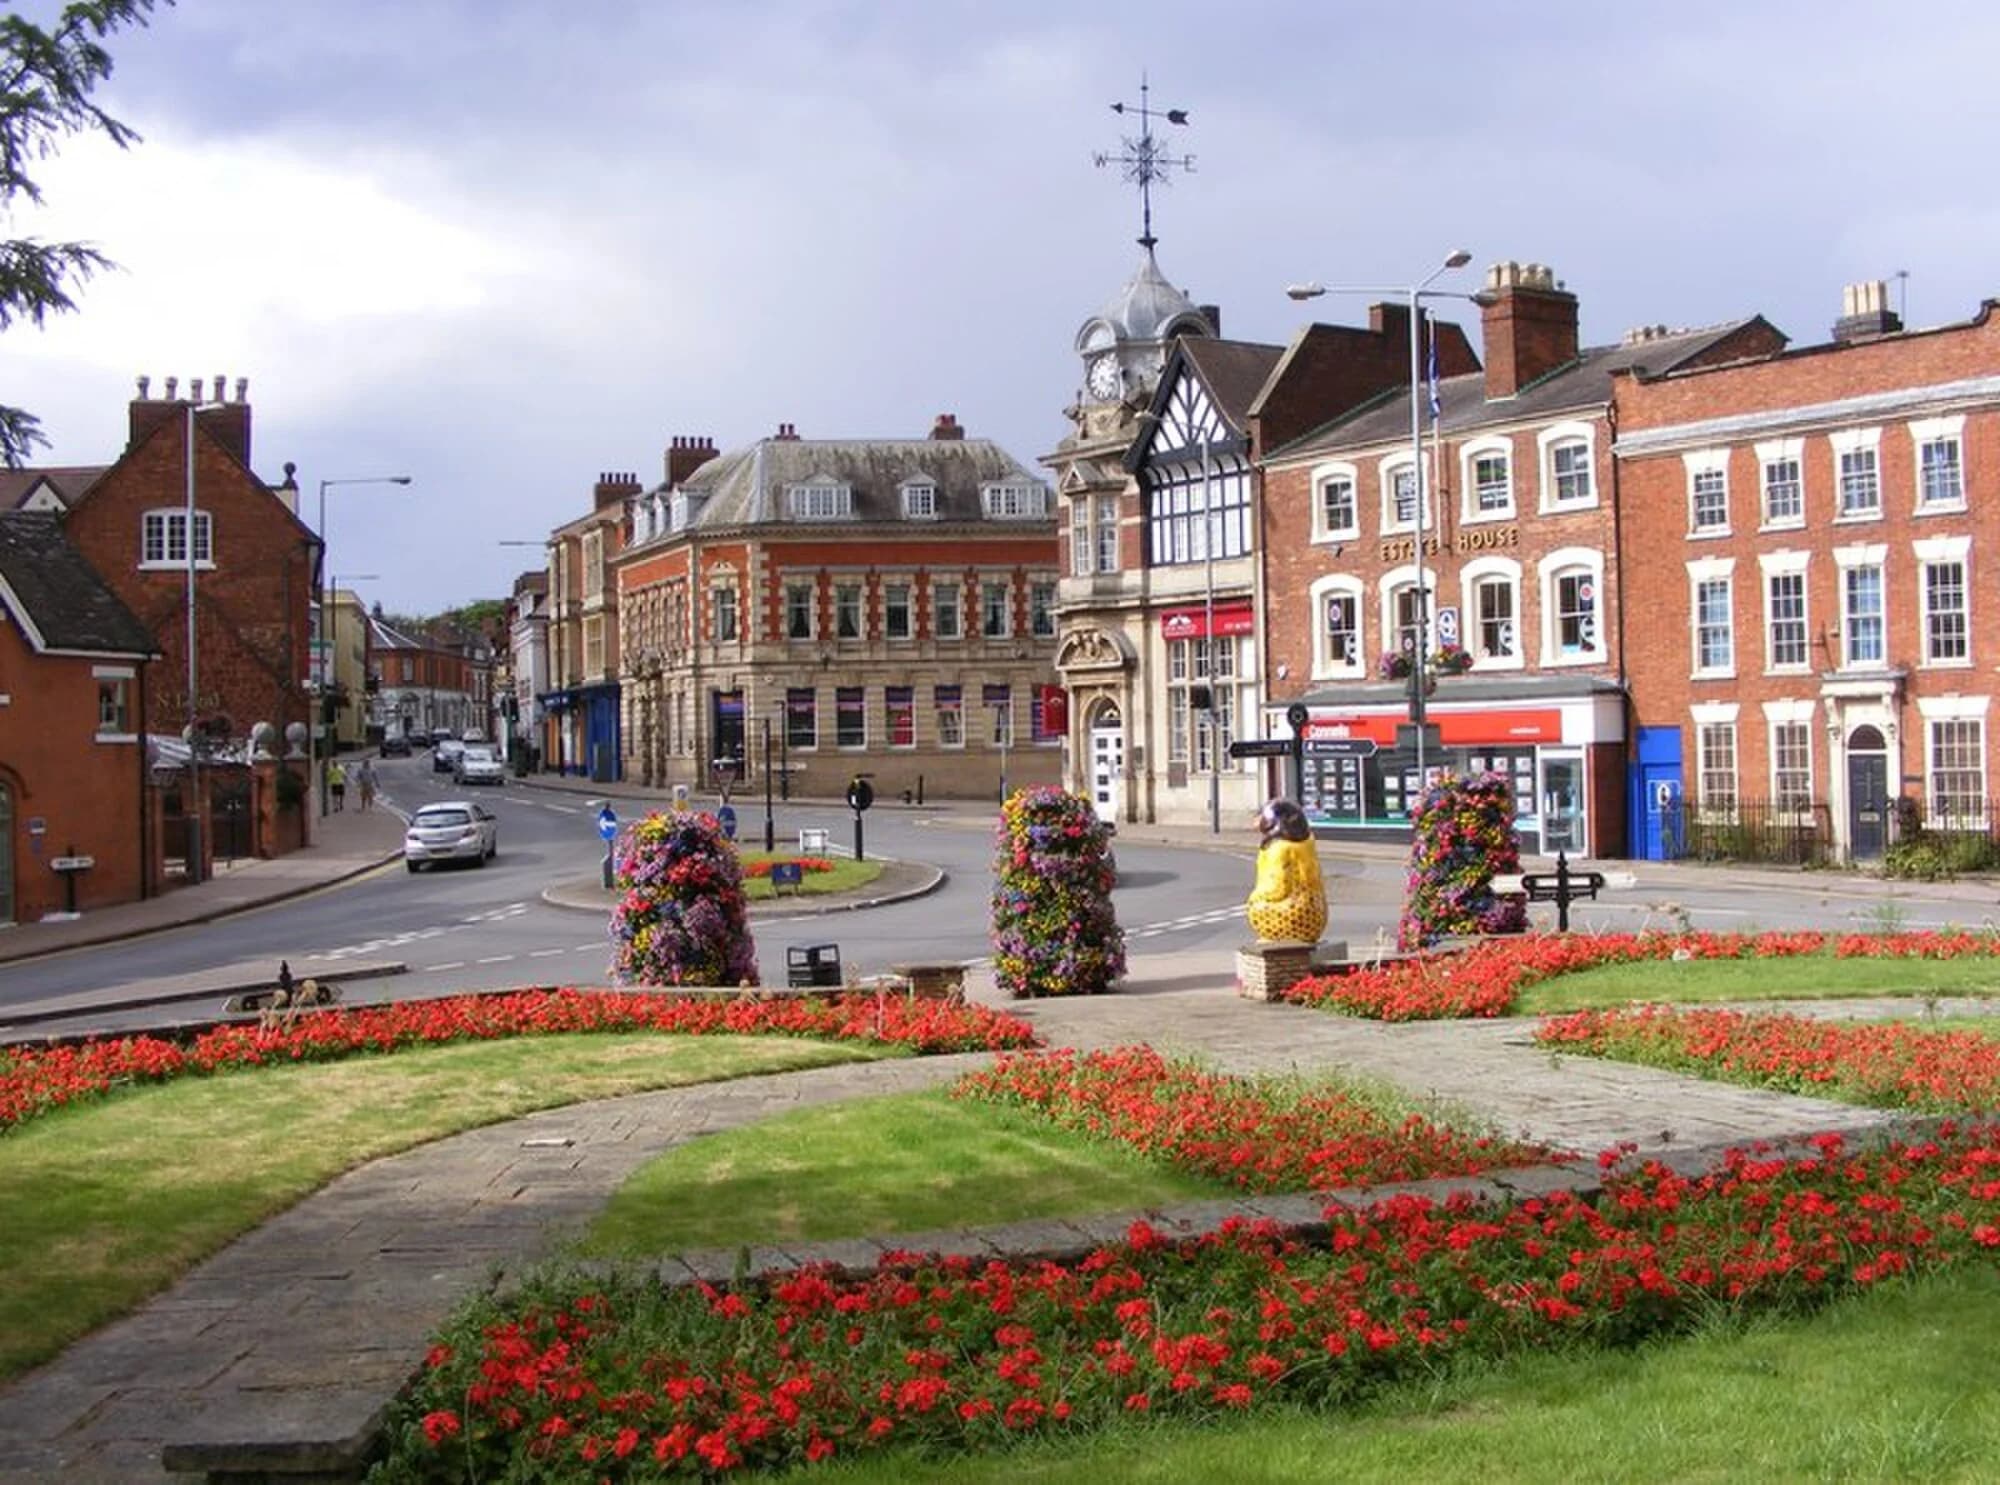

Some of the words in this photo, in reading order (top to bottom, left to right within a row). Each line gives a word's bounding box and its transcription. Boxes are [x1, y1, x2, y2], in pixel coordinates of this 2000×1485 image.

[1092, 151, 1107, 168] W
[1185, 154, 1198, 173] E
[1458, 527, 1520, 551] HOUSE
